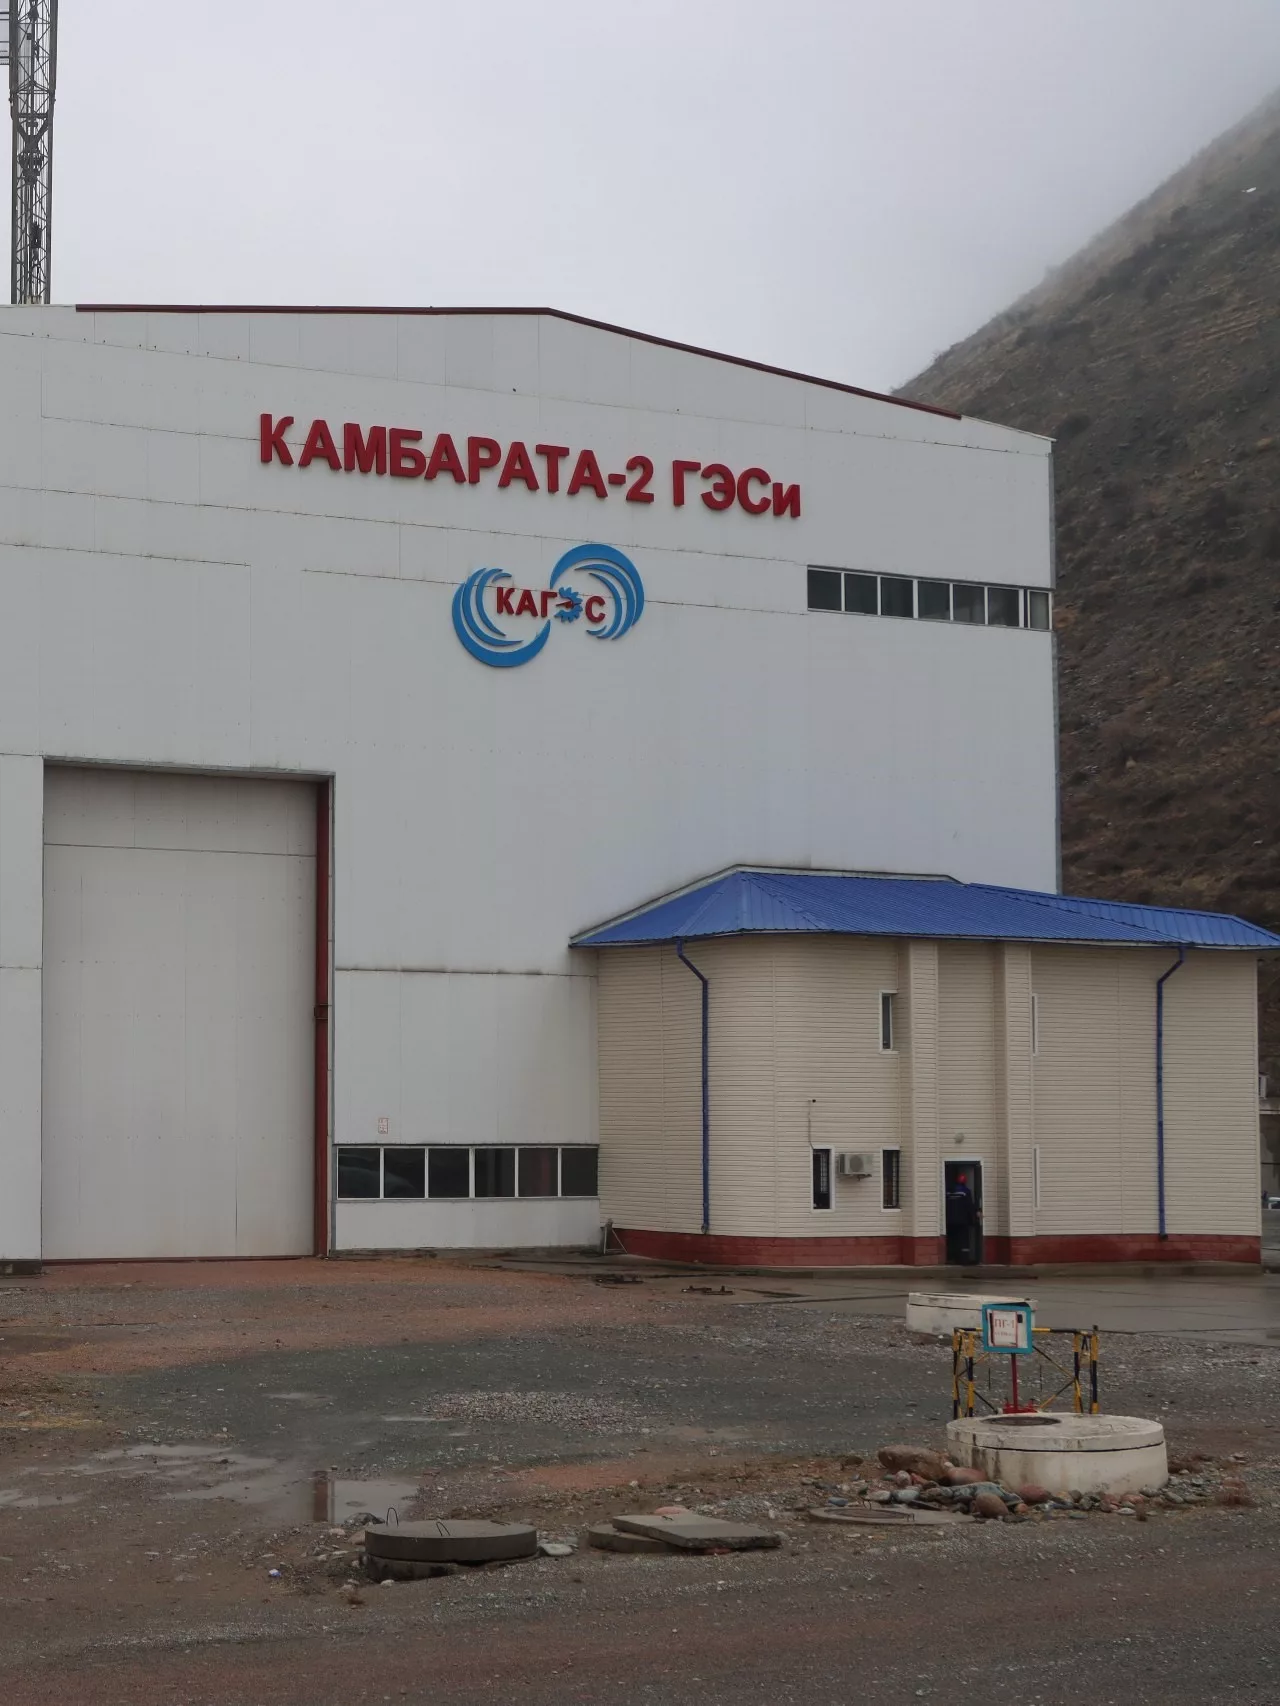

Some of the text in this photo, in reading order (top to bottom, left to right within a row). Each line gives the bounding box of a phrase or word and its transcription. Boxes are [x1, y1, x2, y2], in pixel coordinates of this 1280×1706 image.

[259, 413, 801, 518] КАМБАРАТА-2 ГЭСи
[495, 586, 606, 623] КАГЭС
